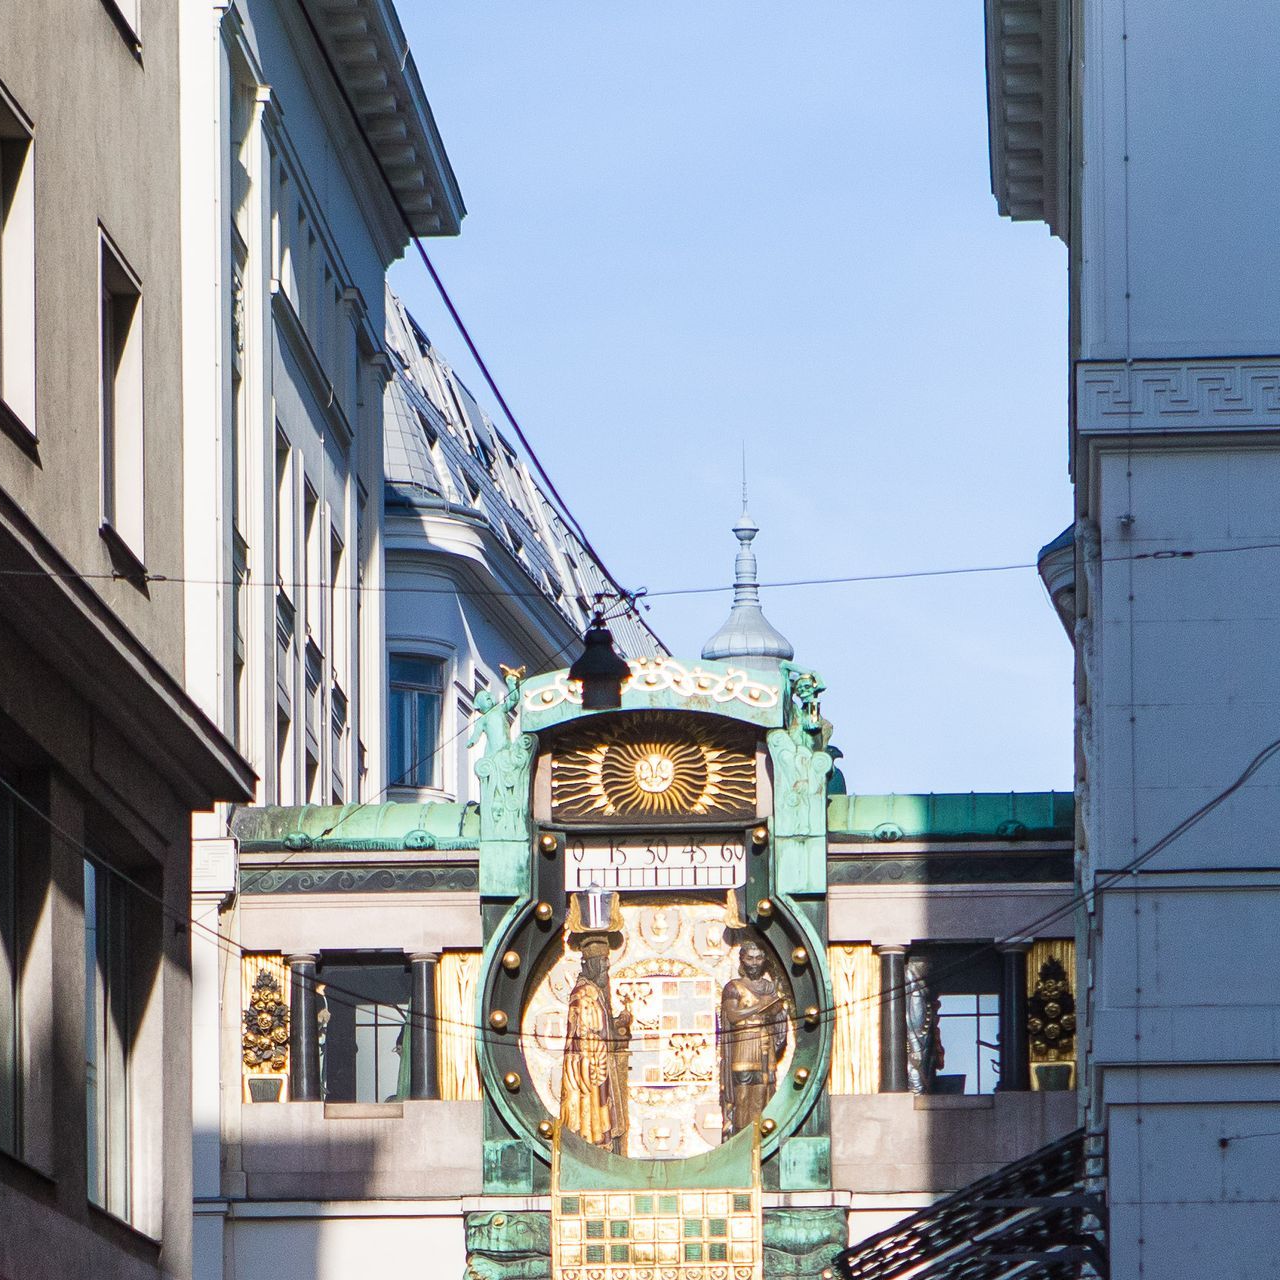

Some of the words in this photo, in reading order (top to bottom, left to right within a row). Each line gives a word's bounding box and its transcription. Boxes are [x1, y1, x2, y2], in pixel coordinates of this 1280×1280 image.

[572, 838, 585, 863] 0
[608, 838, 627, 865] 15
[642, 838, 669, 865] 30
[682, 837, 707, 864] 45
[721, 838, 746, 863] 60
